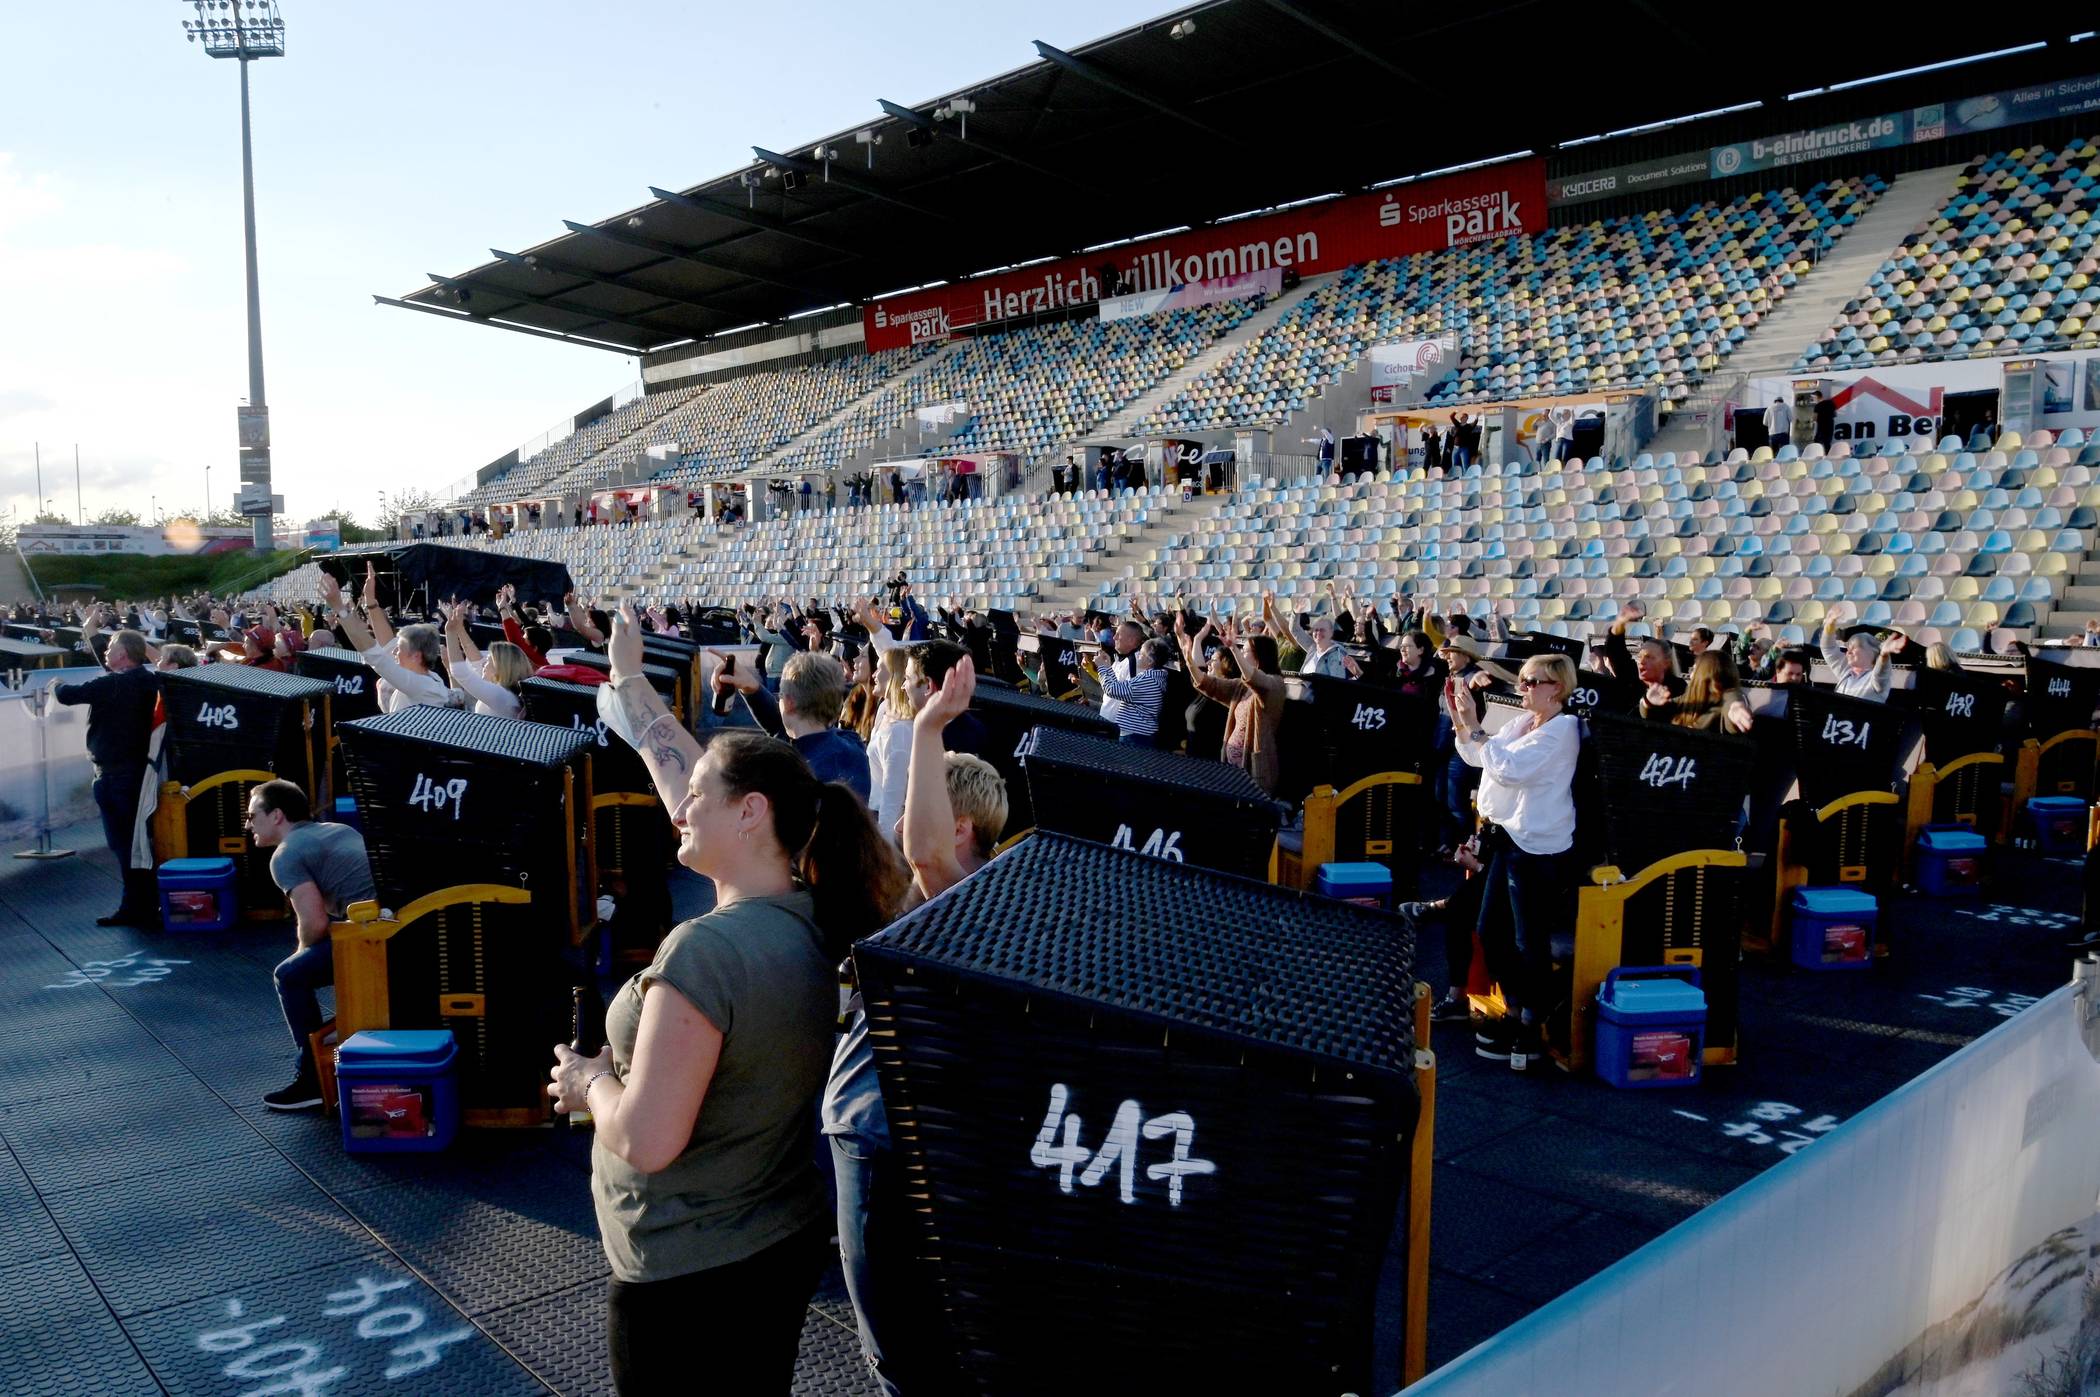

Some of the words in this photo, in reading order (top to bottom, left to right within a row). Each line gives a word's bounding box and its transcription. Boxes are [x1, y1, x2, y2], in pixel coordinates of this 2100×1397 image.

[2012, 91, 2041, 104] Alles
[2044, 88, 2054, 97] in
[1752, 117, 1895, 160] b-eindruck.de
[1914, 127, 1943, 142] BASI
[1774, 153, 1788, 166] DIE
[1790, 141, 1871, 164] TEXTILDRUCKEREI
[1562, 176, 1616, 198] KYOCERA
[1627, 168, 1669, 184] Document
[1670, 161, 1708, 176] Solutions
[1408, 192, 1500, 224] Sparkassen
[1446, 190, 1522, 247] park
[1454, 227, 1523, 246] MÖNCHENGLADBACH
[984, 266, 1099, 322] Herzlich
[889, 307, 938, 328] Sparkassen
[911, 306, 950, 344] park
[335, 674, 364, 695] 402
[2047, 677, 2071, 698] 444
[196, 701, 239, 729] 403
[1351, 702, 1386, 730] 423
[1945, 691, 1975, 718] 438
[1821, 713, 1870, 750] 431
[1639, 752, 1696, 791] 424
[409, 773, 467, 820] 409
[1030, 1082, 1216, 1207] 417
